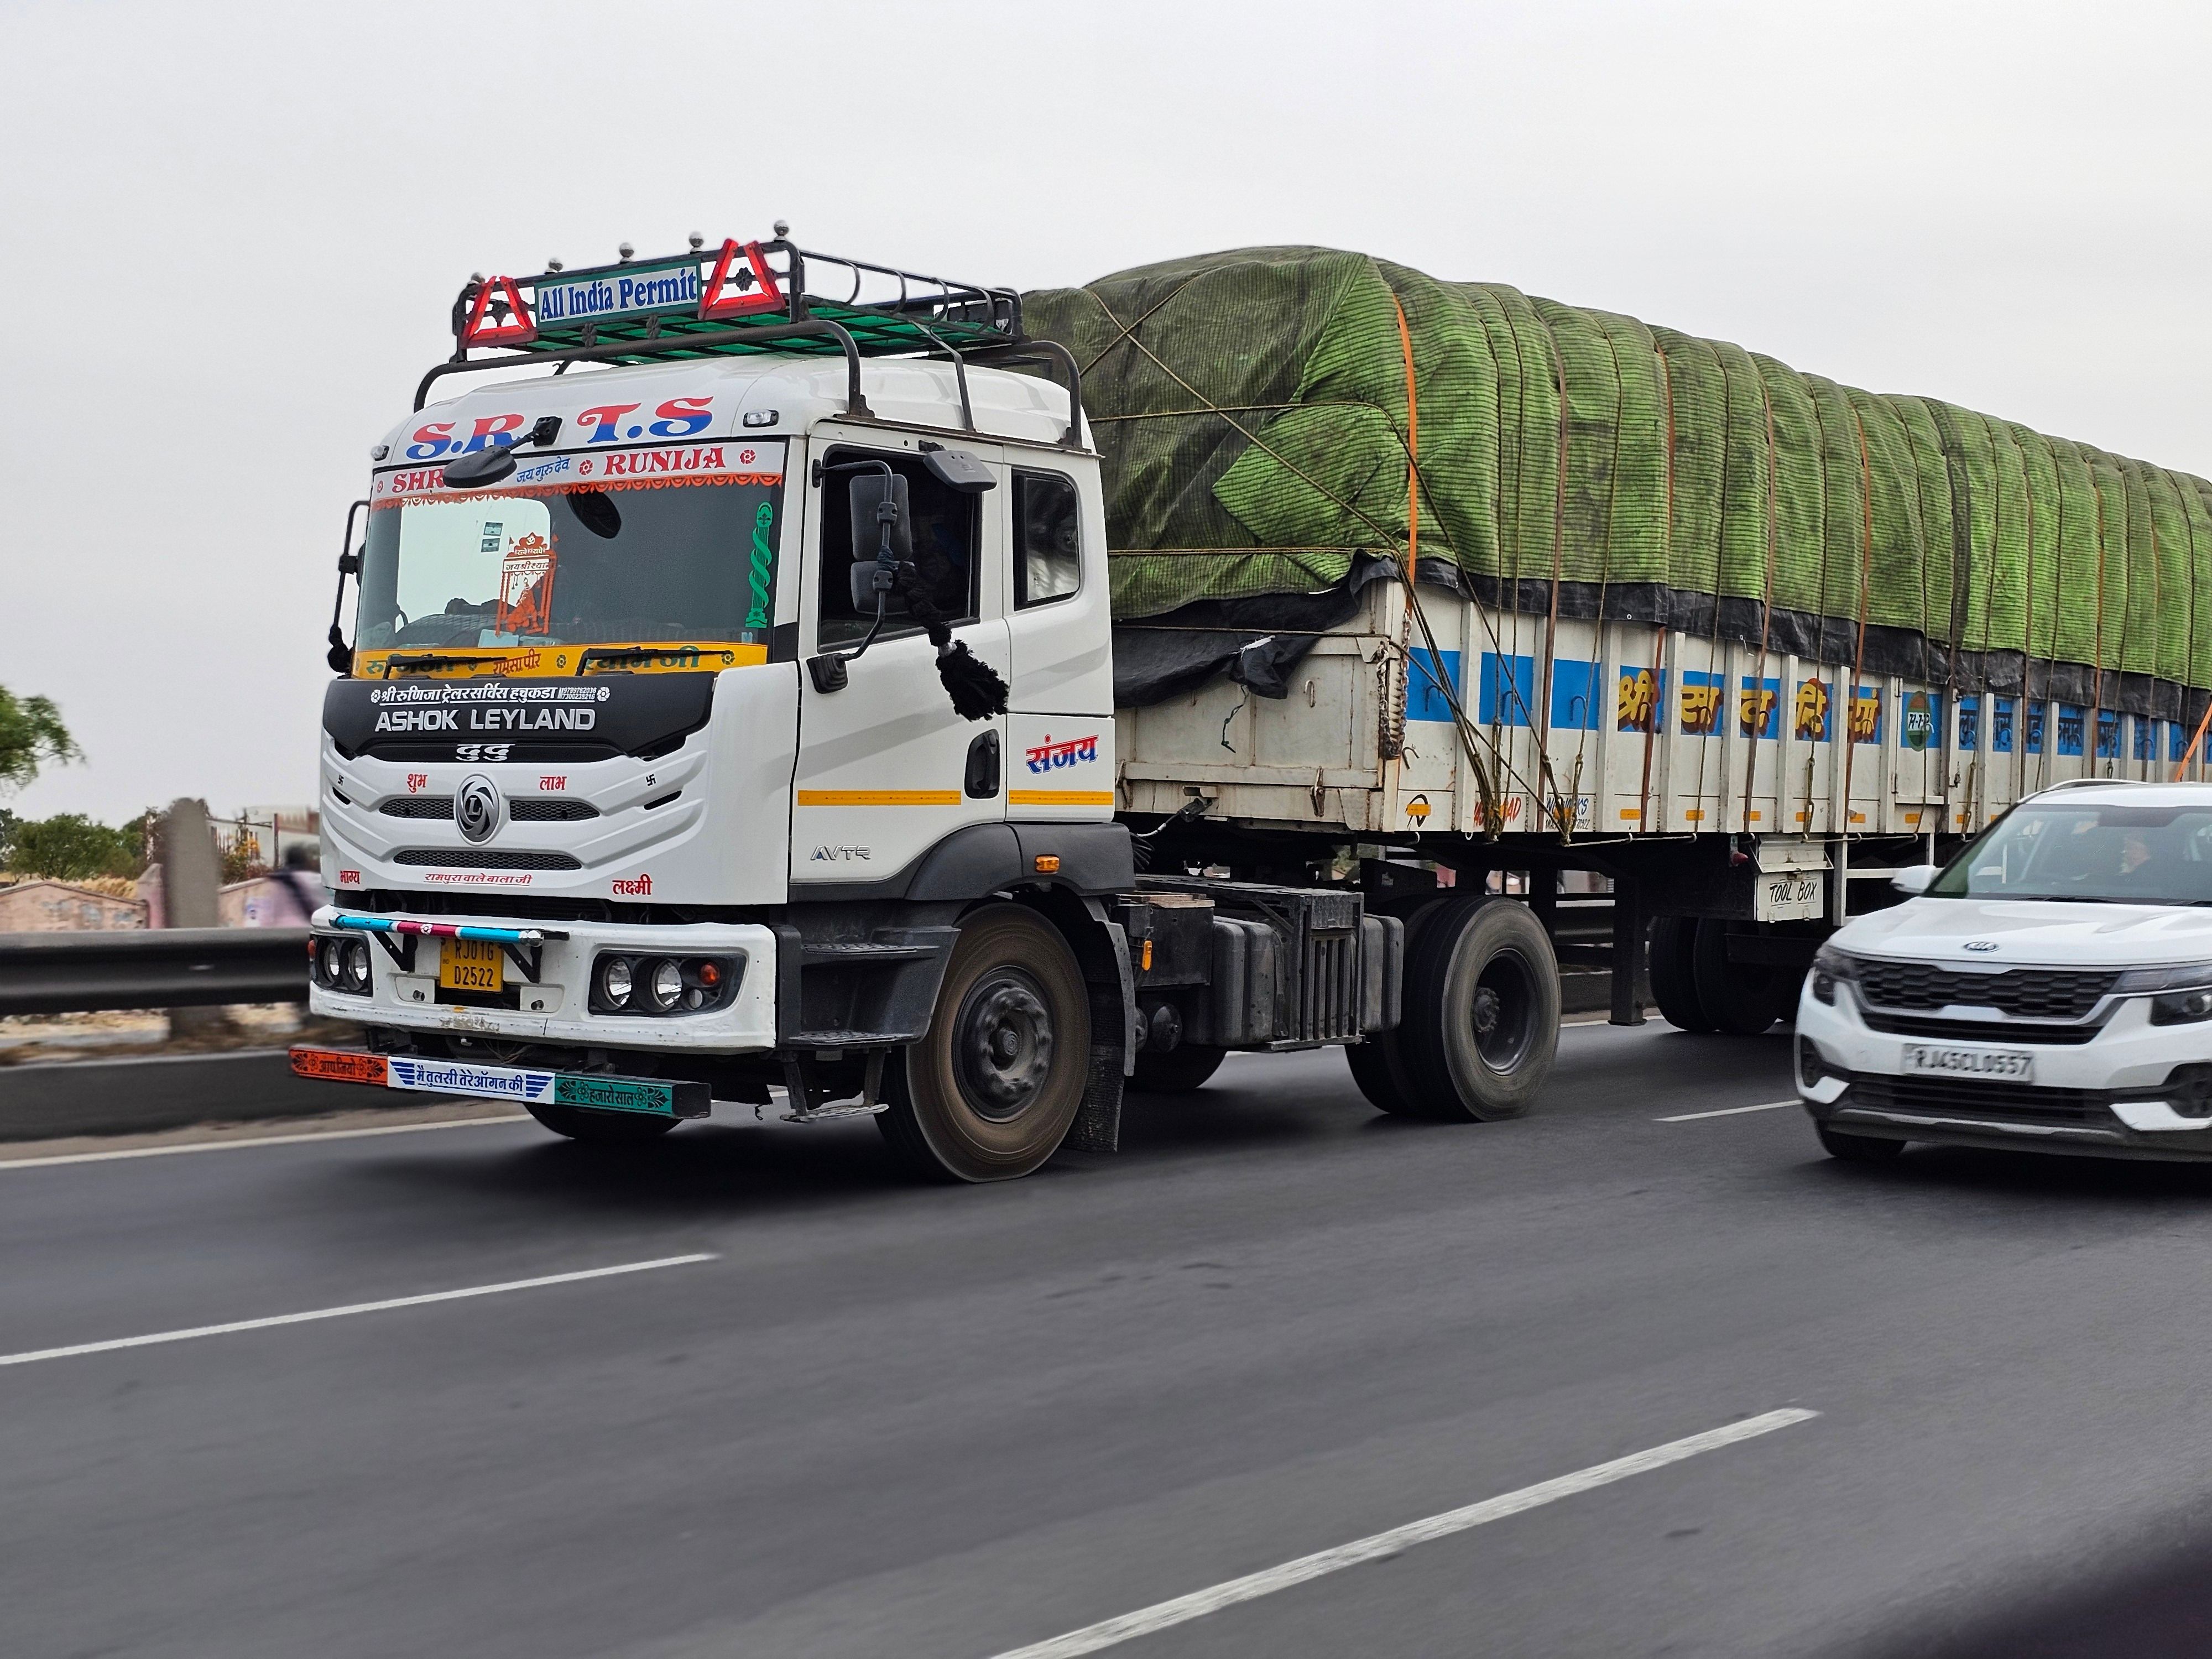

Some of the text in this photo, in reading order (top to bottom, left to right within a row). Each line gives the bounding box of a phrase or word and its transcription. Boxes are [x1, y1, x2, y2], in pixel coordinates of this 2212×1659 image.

[541, 268, 697, 320] All India Permit
[577, 396, 714, 444] T.S
[517, 471, 535, 483] जय
[555, 456, 571, 473] देव
[603, 447, 727, 476] RUNIJA
[392, 469, 446, 493] SHR
[375, 709, 595, 732] ASHOK LEYLAND
[1026, 734, 1099, 774] संजय
[407, 774, 428, 793] शुभ
[540, 776, 567, 790] लाभ
[810, 846, 870, 860] AVTR
[340, 869, 360, 885] भाग्य
[425, 874, 462, 884] रामपुरा
[463, 873, 486, 882] वाले
[613, 874, 653, 895] लक्ष्मी
[1770, 881, 1817, 902] TOOL BOX
[455, 940, 494, 961] RJ01G
[455, 966, 494, 987] D2522
[426, 1068, 458, 1087] तुलसी
[508, 1075, 524, 1092] की
